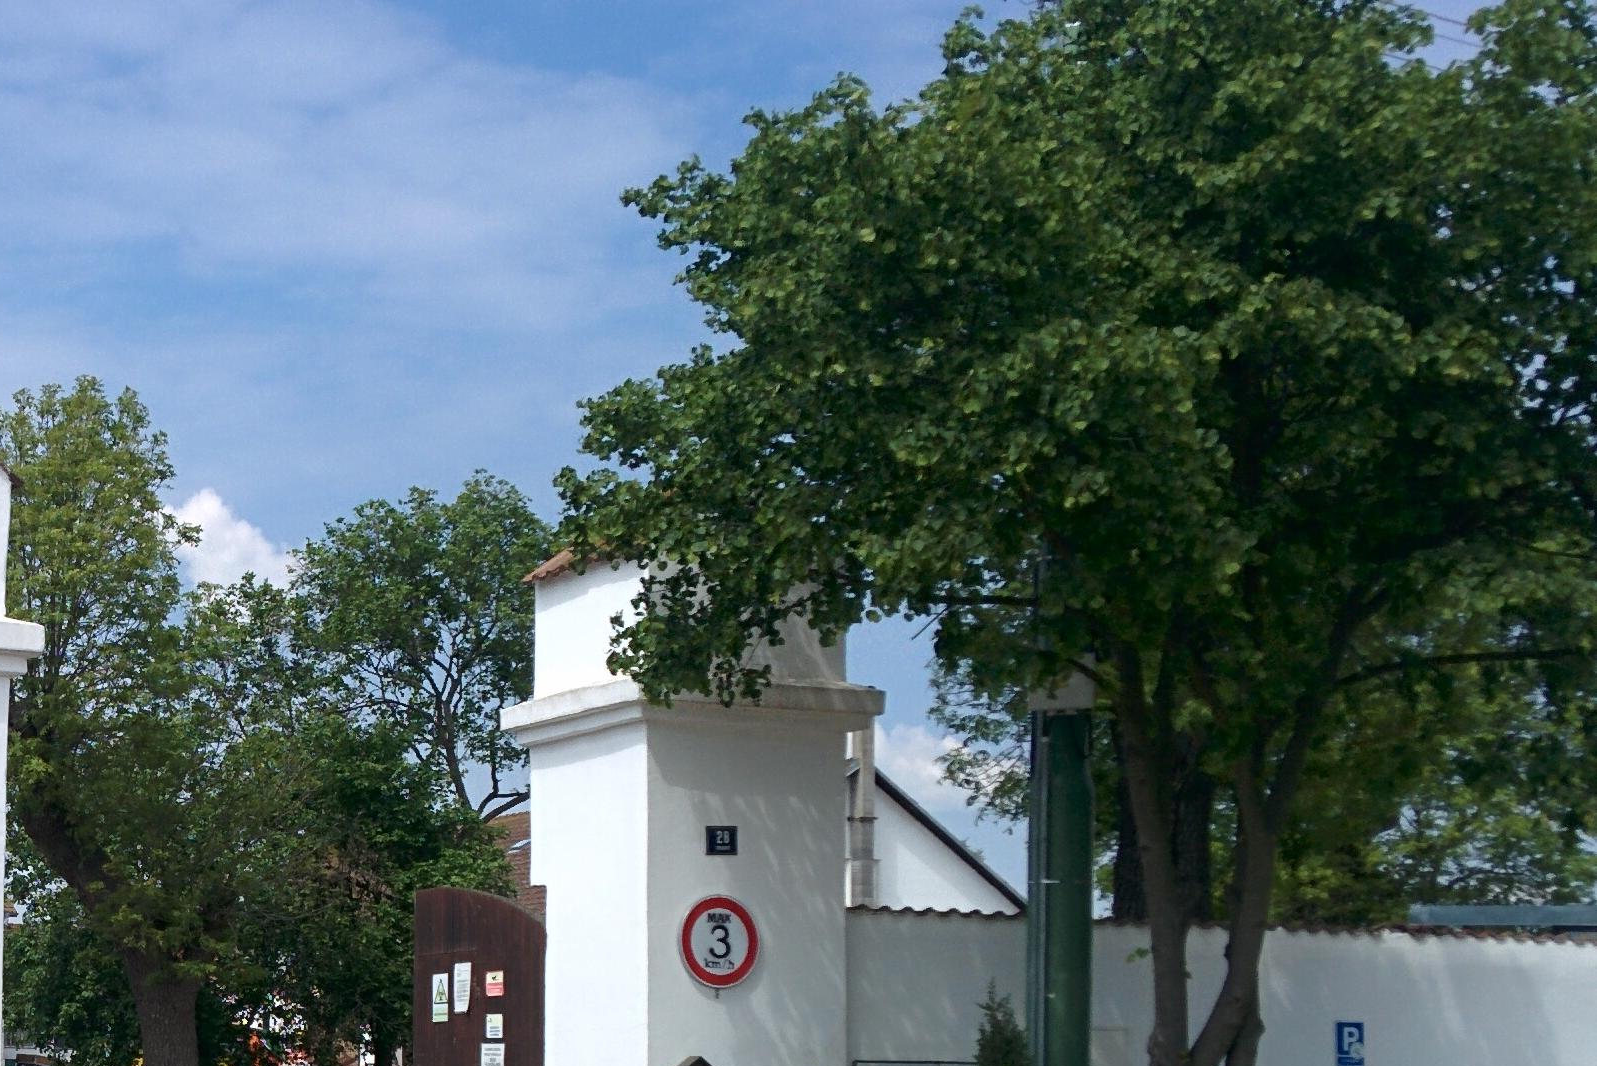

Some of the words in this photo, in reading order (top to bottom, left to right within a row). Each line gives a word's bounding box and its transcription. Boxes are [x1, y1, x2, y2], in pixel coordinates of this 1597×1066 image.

[707, 912, 731, 924] MAX
[709, 924, 731, 959] 3
[704, 957, 735, 970] km/h
[1343, 1026, 1360, 1052] P
